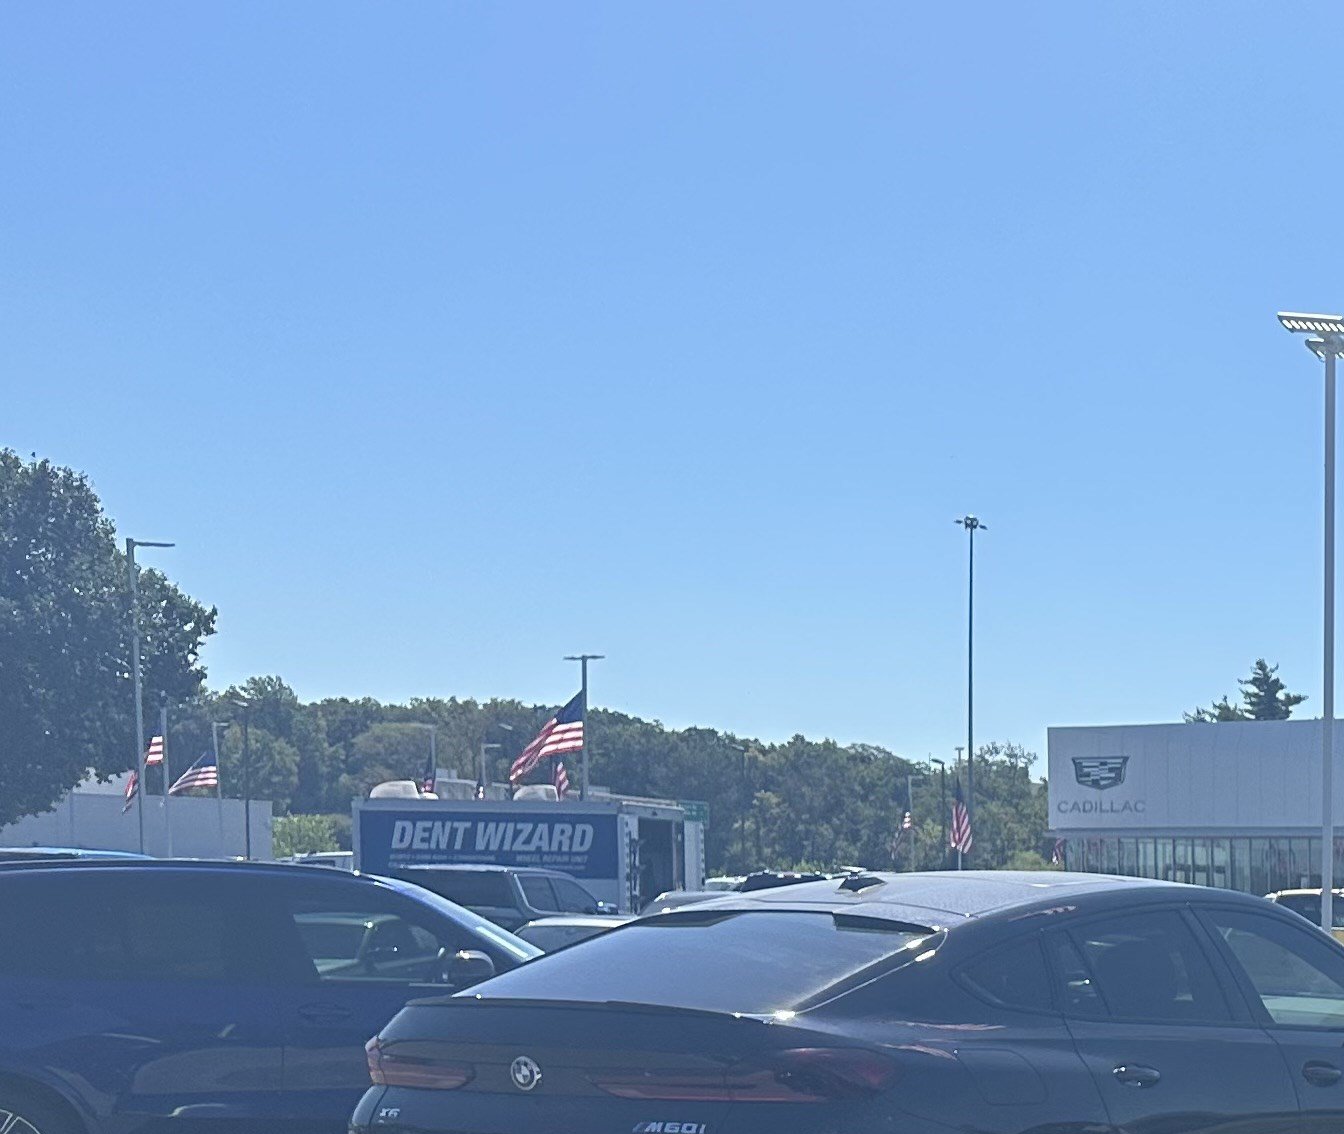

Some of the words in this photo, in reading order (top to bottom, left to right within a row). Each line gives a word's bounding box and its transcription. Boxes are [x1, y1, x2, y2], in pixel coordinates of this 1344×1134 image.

[1057, 800, 1146, 813] CADILLAC
[391, 820, 471, 850] DENT
[475, 821, 594, 851] WIZARD
